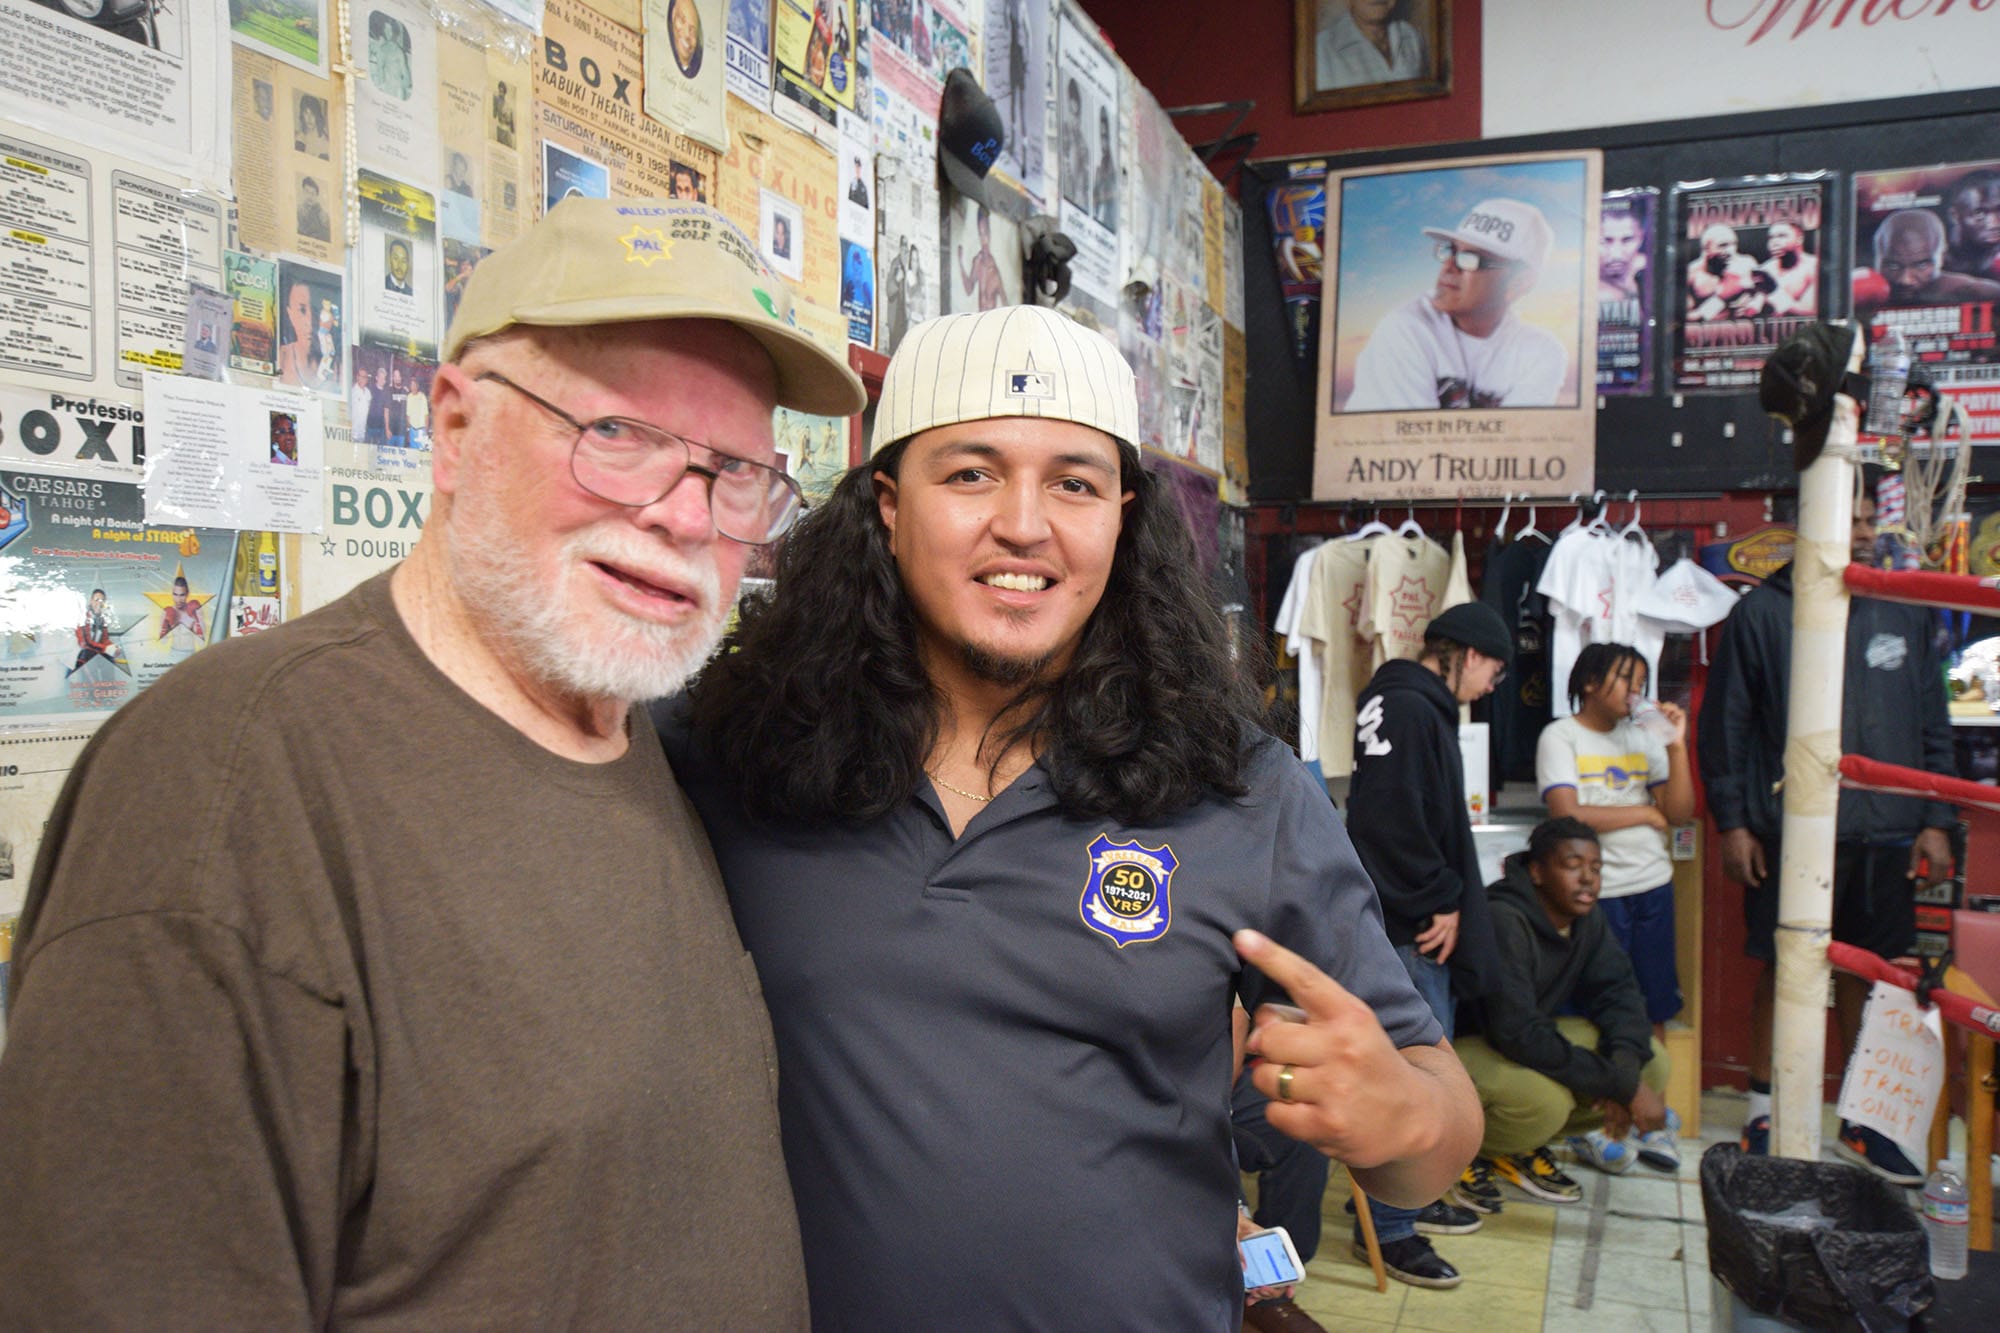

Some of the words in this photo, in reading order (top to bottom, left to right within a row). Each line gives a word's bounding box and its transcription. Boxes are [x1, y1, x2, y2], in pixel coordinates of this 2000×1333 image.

[24, 13, 54, 32] BOXER
[56, 25, 92, 45] EVERETT
[94, 40, 135, 60] ROBINSON
[542, 67, 586, 101] KABUKI
[591, 90, 636, 127] THEATRE
[638, 120, 671, 145] JAPAN
[674, 135, 710, 164] CENTER
[600, 134, 634, 160] MARCH
[616, 207, 666, 217] VALLEJO
[667, 207, 708, 217] POLICE
[670, 229, 712, 242] GOLF
[1463, 212, 1515, 244] POPS
[633, 239, 663, 252] PAL
[1396, 421, 1434, 435] REST
[1438, 419, 1451, 433] IN
[1456, 419, 1504, 434] PEACE
[403, 458, 417, 469] You
[1346, 457, 1423, 483] ANDY
[1429, 452, 1567, 482] TRUJILLO
[331, 467, 403, 483] PROFESSIONAL
[13, 476, 103, 498] CAESARS
[38, 495, 95, 511] TAHOE
[51, 513, 61, 524] A
[62, 515, 92, 527] night
[93, 516, 105, 527] of
[107, 517, 144, 532] Boxing
[92, 528, 102, 540] A
[103, 530, 131, 543] night
[132, 530, 144, 542] of
[145, 530, 186, 544] STARS
[94, 689, 128, 698] GILBERT
[1113, 869, 1144, 889] 50
[1104, 885, 1151, 902] 1971-2021
[1111, 896, 1142, 912] YRS
[1875, 1049, 1932, 1080] ONLY
[1862, 1069, 1925, 1109] TRASH
[1860, 1097, 1916, 1135] ONLY
